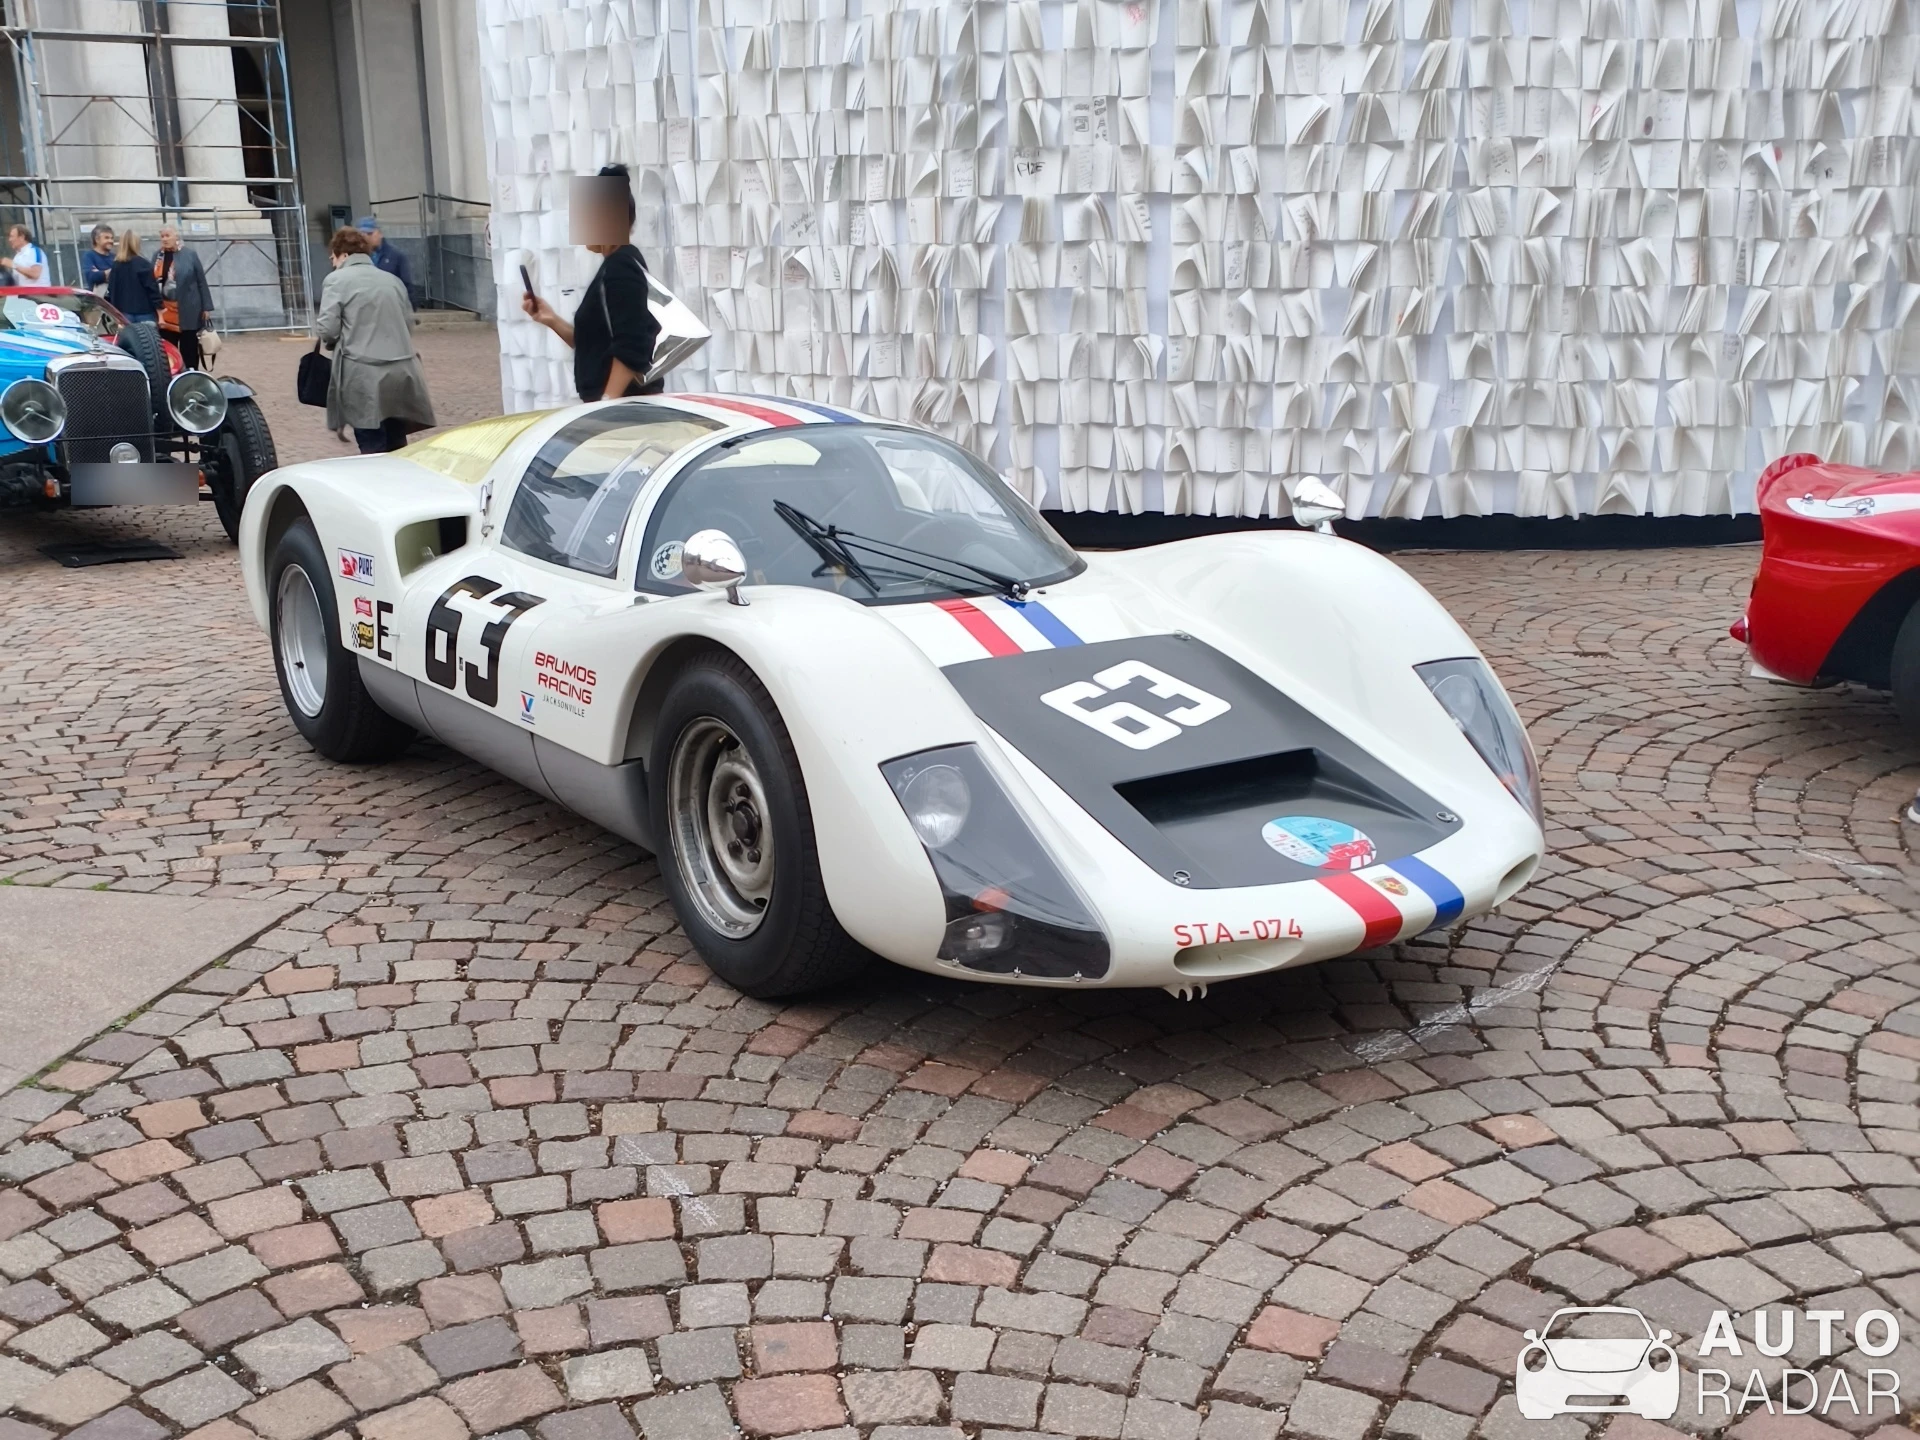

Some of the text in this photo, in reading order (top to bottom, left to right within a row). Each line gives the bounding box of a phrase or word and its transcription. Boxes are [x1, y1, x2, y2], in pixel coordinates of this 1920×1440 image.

[40, 307, 60, 320] 29
[358, 556, 373, 577] PURE
[377, 600, 393, 661] E
[426, 575, 547, 708] 63
[535, 651, 597, 686] BRUMOS
[538, 672, 592, 704] RACING
[542, 694, 585, 718] JACKSONVILLE
[1039, 659, 1232, 750] 63
[1174, 918, 1303, 946] STA-074
